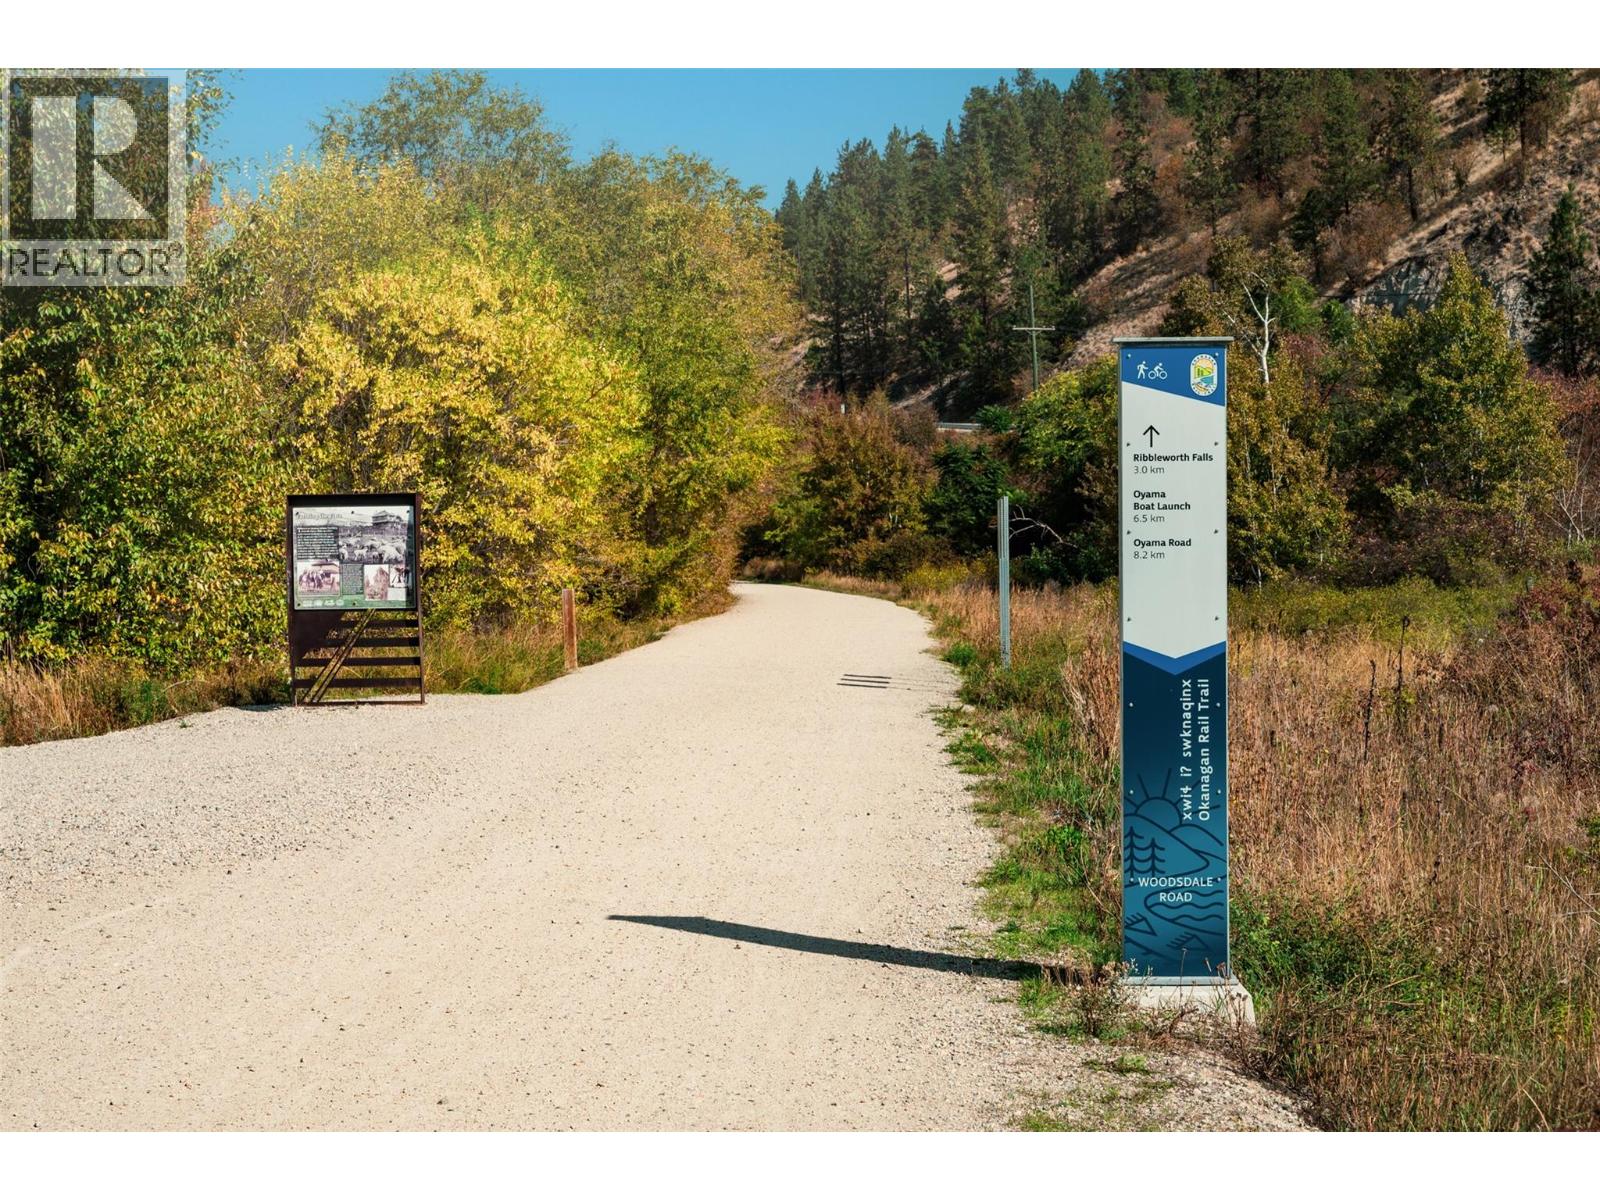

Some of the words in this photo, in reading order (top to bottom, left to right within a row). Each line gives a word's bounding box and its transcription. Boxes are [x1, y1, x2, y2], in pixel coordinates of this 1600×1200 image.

[1133, 453, 1190, 462] Ribbleworth
[1192, 453, 1214, 462] Falls
[1133, 465, 1148, 474] 3.0
[1150, 465, 1165, 474] km
[1133, 490, 1166, 500] Oyama
[1133, 502, 1155, 511] Boat
[1157, 501, 1191, 511] Launch
[1133, 514, 1148, 523] 6.5
[1150, 514, 1165, 523] km
[1133, 538, 1166, 549] Oyama
[1168, 538, 1192, 547] Road
[1133, 550, 1148, 559] 8.2
[1150, 550, 1165, 559] km
[1197, 678, 1210, 712] Trail
[1180, 678, 1195, 758] swknaqinx
[1197, 716, 1210, 743] Rail
[1198, 748, 1213, 821] Okanagan
[1137, 877, 1214, 887] WOODSDALE
[1159, 892, 1193, 902] ROAD
